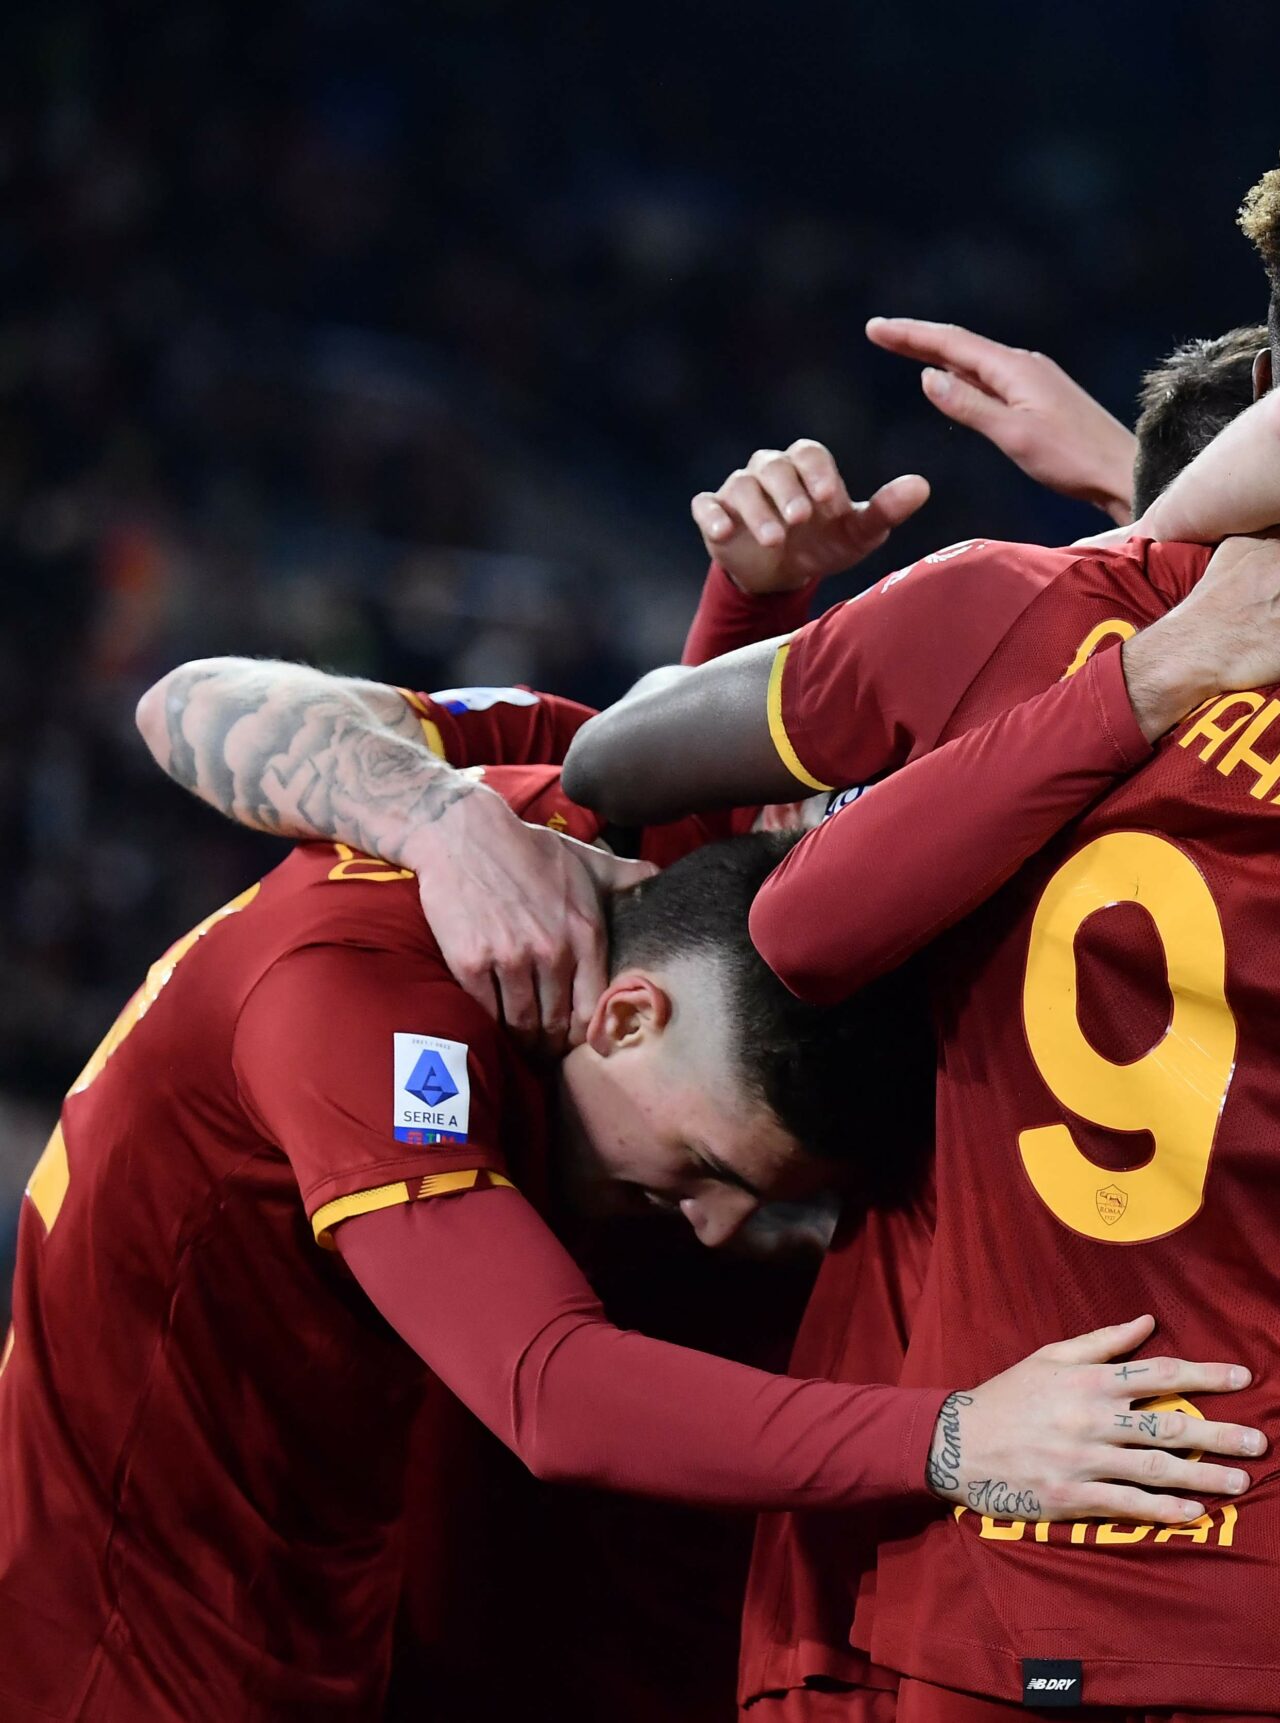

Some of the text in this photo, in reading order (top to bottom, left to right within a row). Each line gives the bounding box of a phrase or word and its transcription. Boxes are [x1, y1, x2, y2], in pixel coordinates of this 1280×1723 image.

[1018, 830, 1238, 1243] 9
[403, 1110, 458, 1127] SERIE A
[1114, 1414, 1133, 1428] H
[1139, 1413, 1158, 1438] 24
